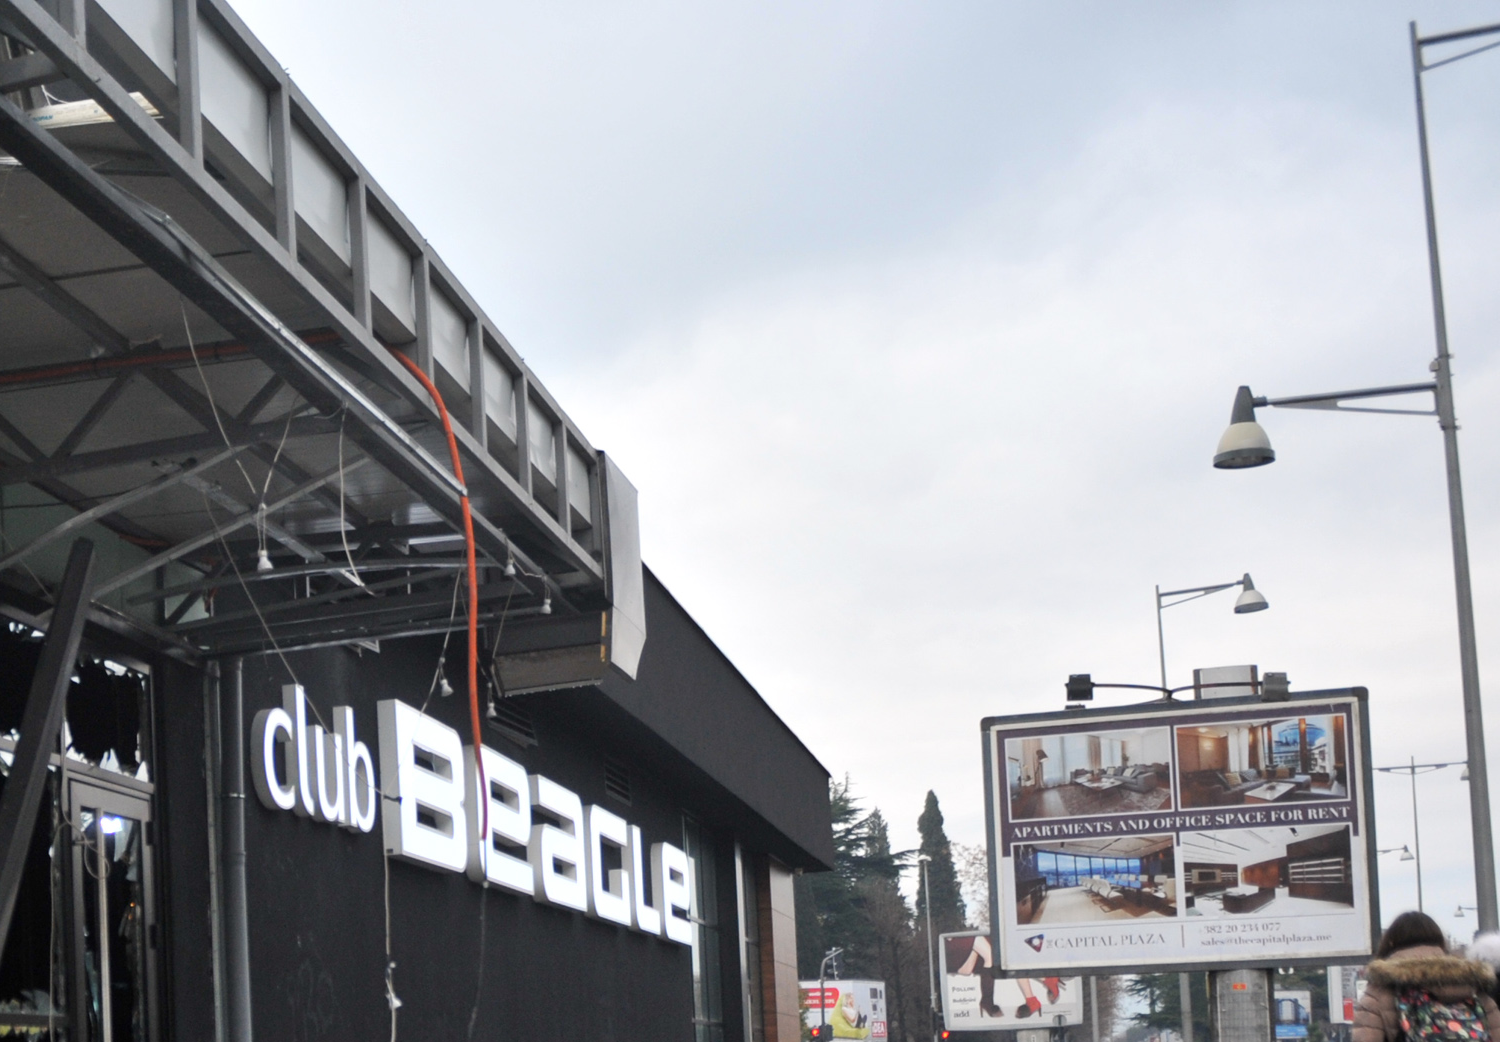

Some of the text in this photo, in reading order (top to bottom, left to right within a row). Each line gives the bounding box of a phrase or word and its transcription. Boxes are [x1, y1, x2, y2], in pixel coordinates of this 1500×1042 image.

[252, 684, 376, 833] club
[1011, 806, 1350, 838] APARTMENTS AND OFFICE SPACE FOR RENT
[1224, 924, 1238, 934] 20
[1262, 921, 1281, 932] 077
[1054, 935, 1118, 949] CAPITAL
[1120, 933, 1166, 946] PLAZA
